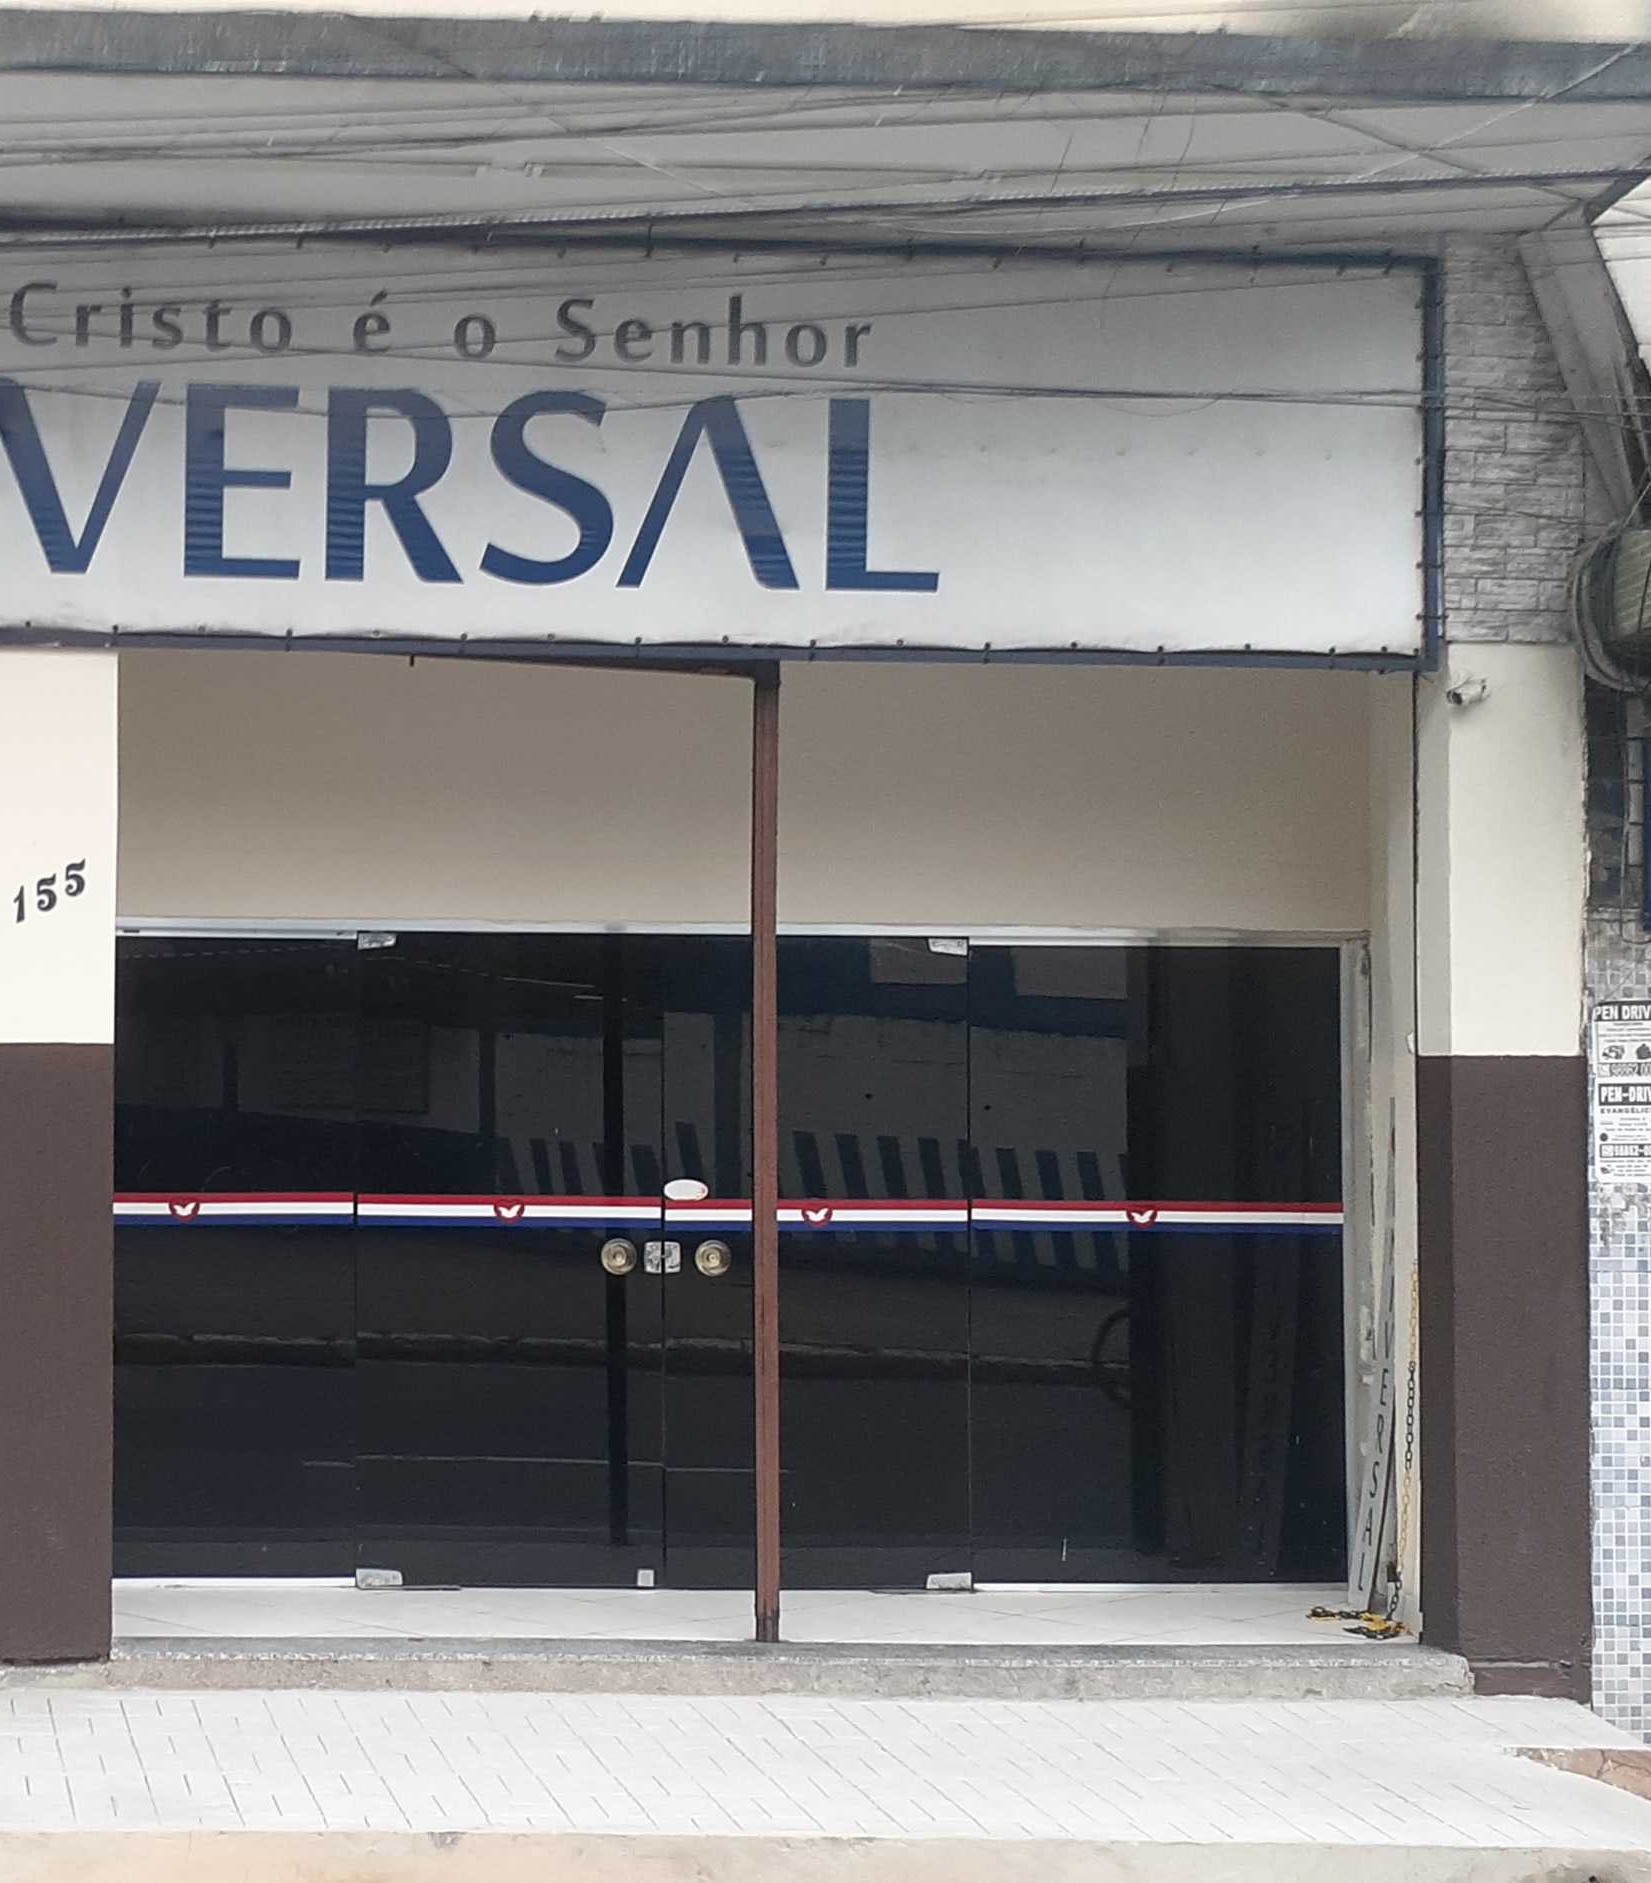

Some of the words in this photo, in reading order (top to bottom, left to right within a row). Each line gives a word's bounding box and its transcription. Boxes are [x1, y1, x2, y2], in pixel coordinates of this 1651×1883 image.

[8, 280, 293, 354] Cristo
[352, 290, 393, 355] é
[453, 313, 497, 361] o
[554, 294, 872, 369] Senhor
[12, 857, 87, 924] 155
[1593, 1005, 1619, 1020] PEN
